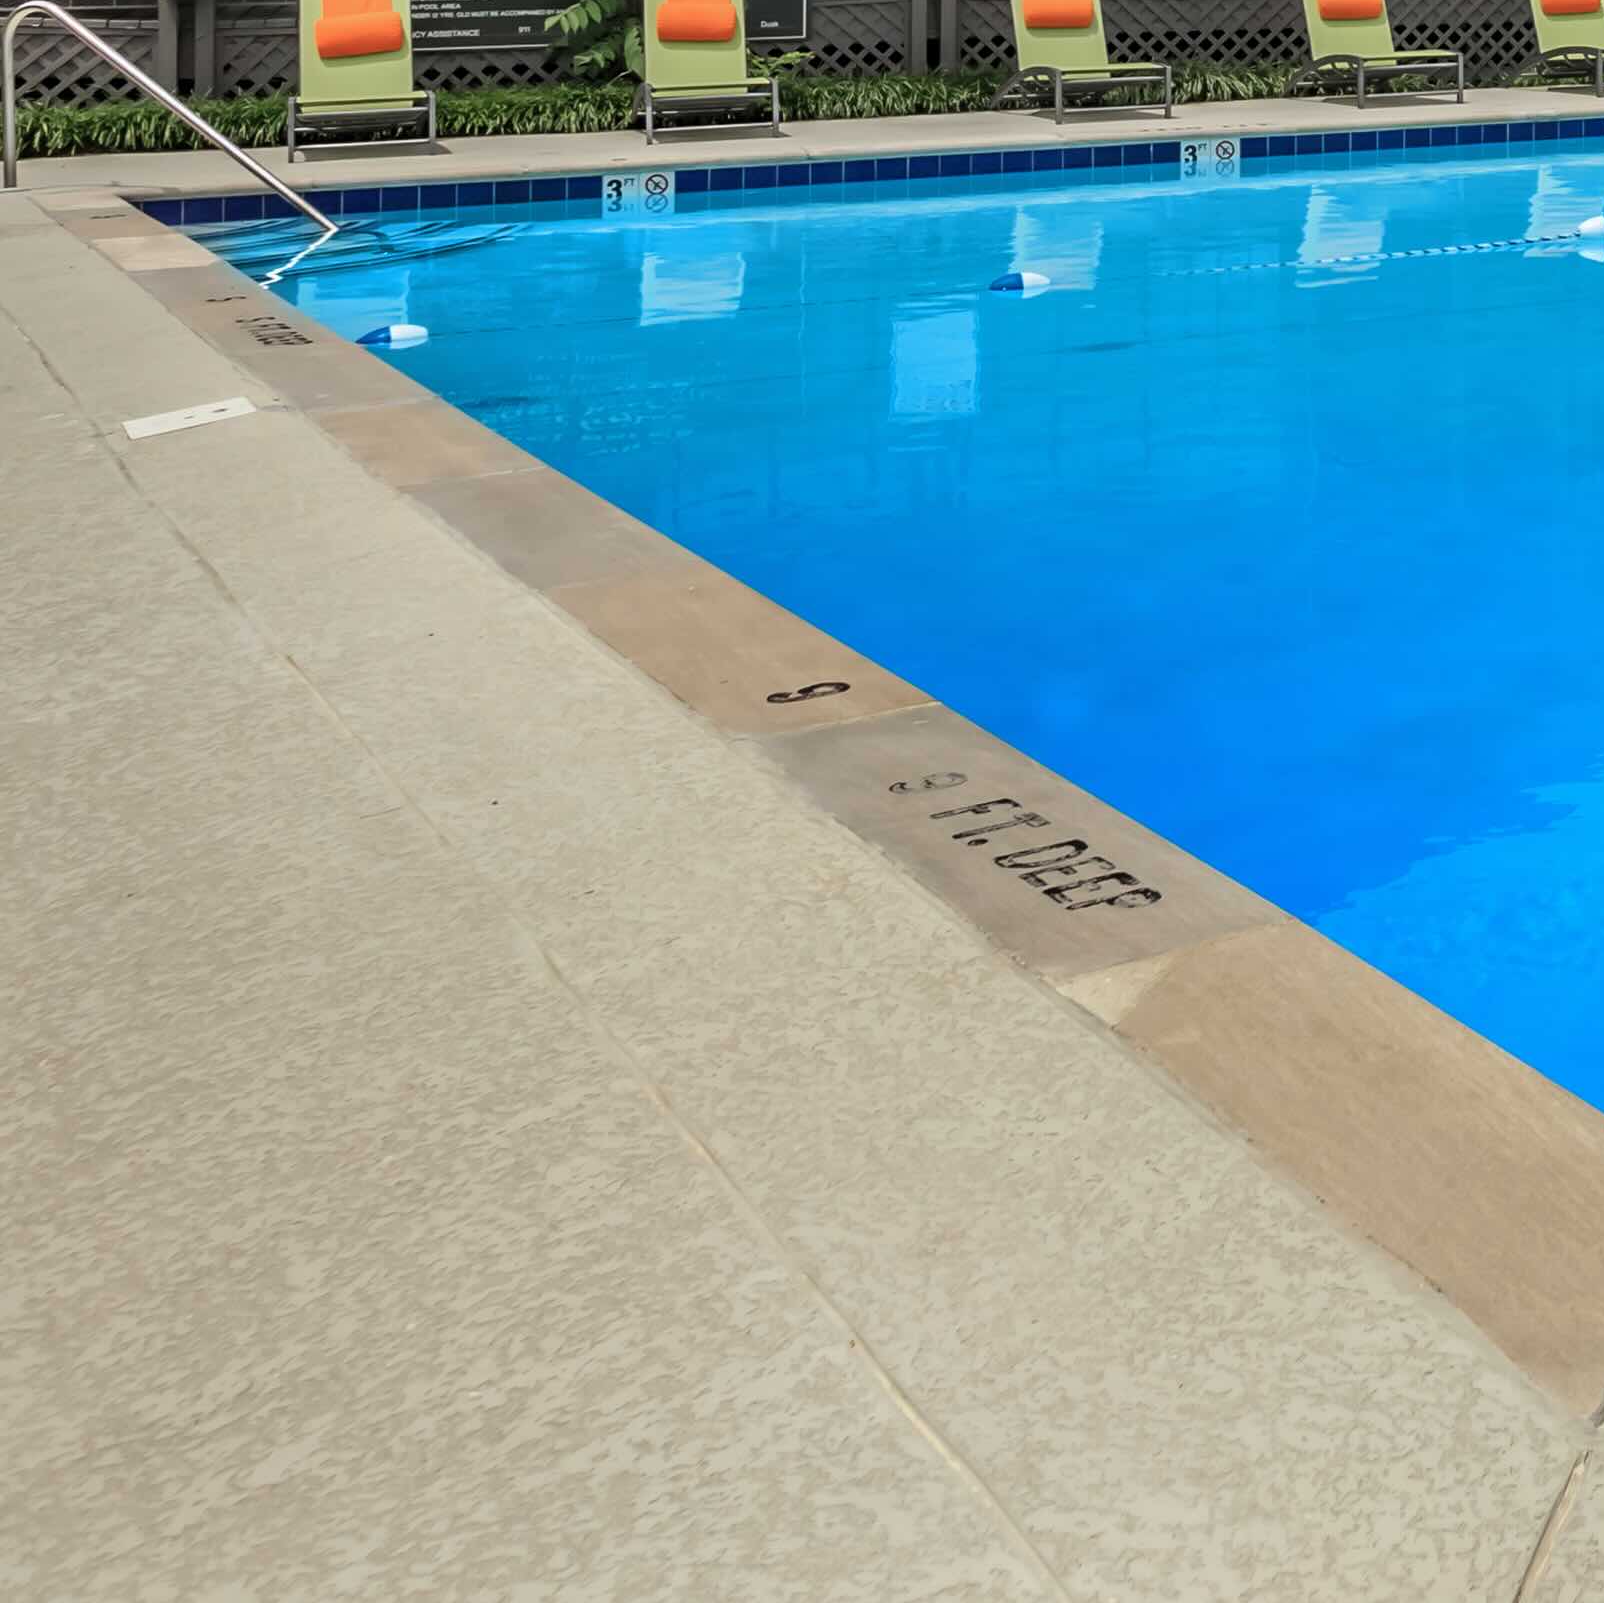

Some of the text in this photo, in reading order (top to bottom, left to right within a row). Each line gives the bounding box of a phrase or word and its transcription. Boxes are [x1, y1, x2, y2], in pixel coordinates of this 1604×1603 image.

[427, 29, 480, 37] ASSISTANCE
[1184, 143, 1208, 164] 3 FT
[607, 179, 623, 198] 3
[993, 838, 1163, 911] DEEP
